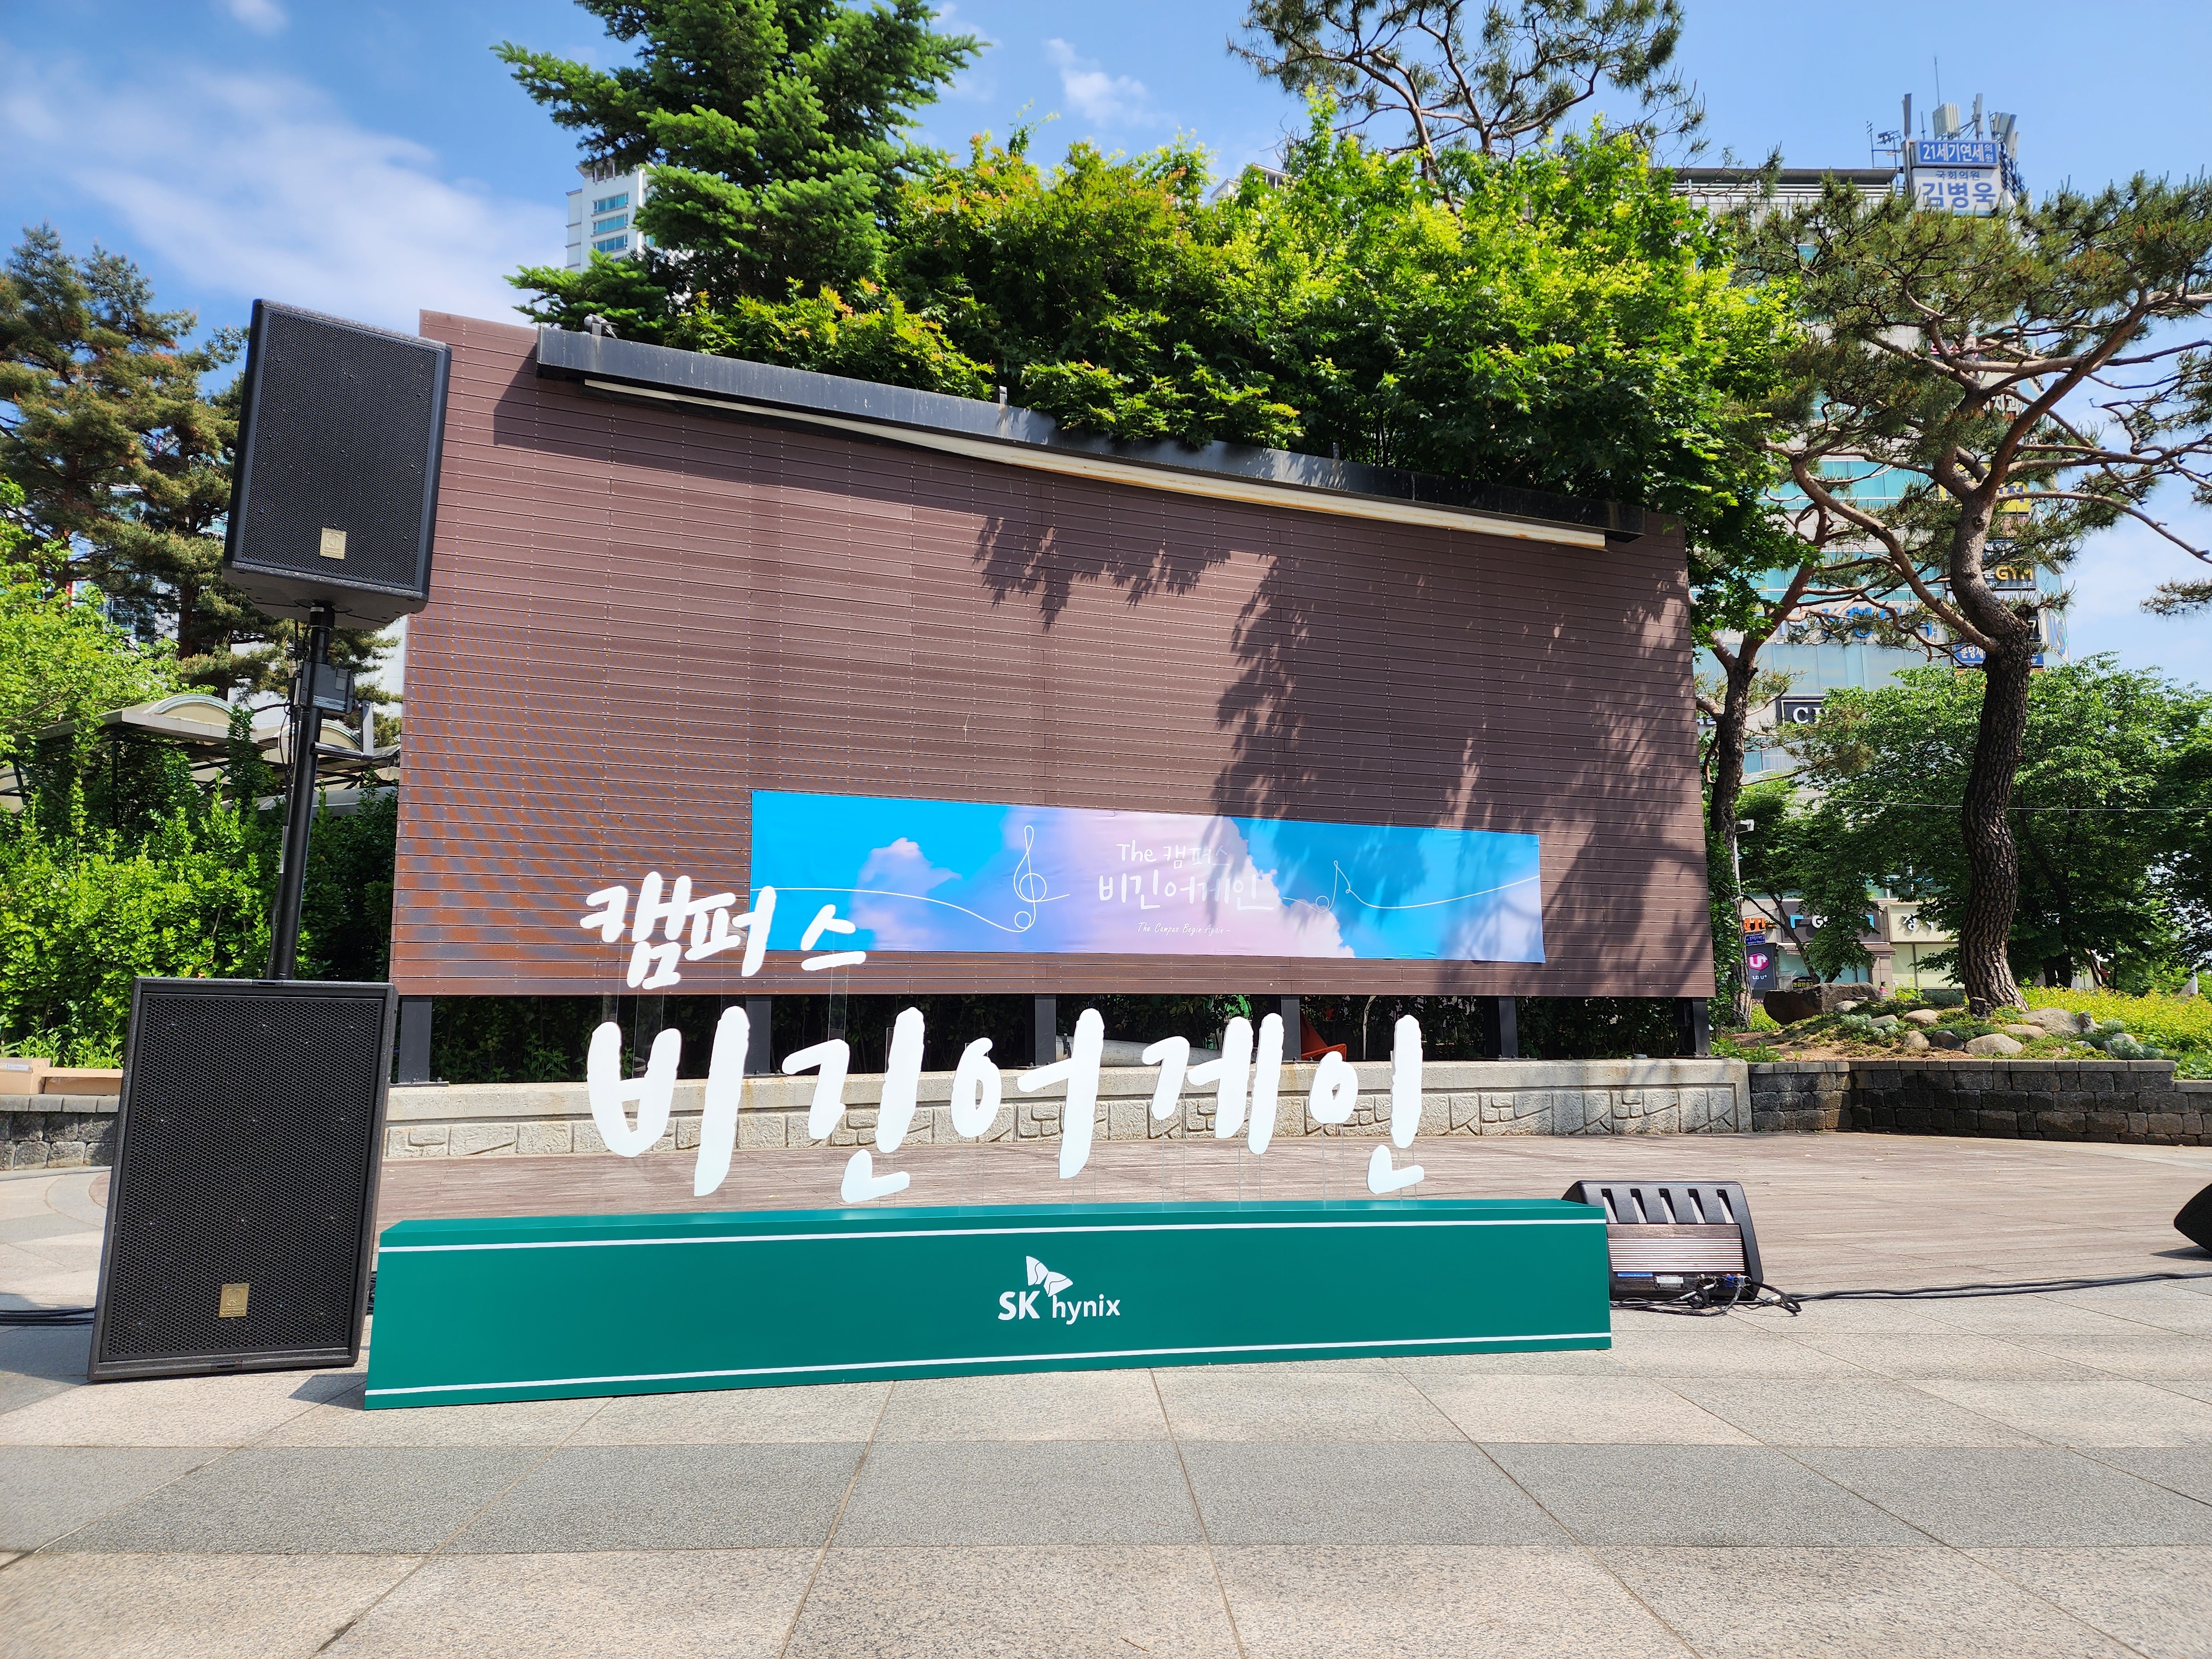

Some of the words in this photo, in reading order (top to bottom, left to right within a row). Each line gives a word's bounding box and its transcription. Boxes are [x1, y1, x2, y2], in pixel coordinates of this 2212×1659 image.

[1936, 170, 1980, 181] 국회의원
[1922, 181, 1996, 208] 김병욱
[1116, 839, 1157, 863] The
[1163, 844, 1230, 869] 캠퍼스
[1099, 869, 1274, 911] 비긴어게인
[581, 873, 866, 989] 캠퍼스
[1138, 922, 1151, 933] The
[1155, 922, 1180, 936] Campus
[1182, 923, 1202, 936] Begin
[1204, 924, 1224, 936] Again
[587, 1005, 1425, 1204] 비긴어게인
[998, 1290, 1040, 1321] SK
[1052, 1293, 1121, 1325] hynix
